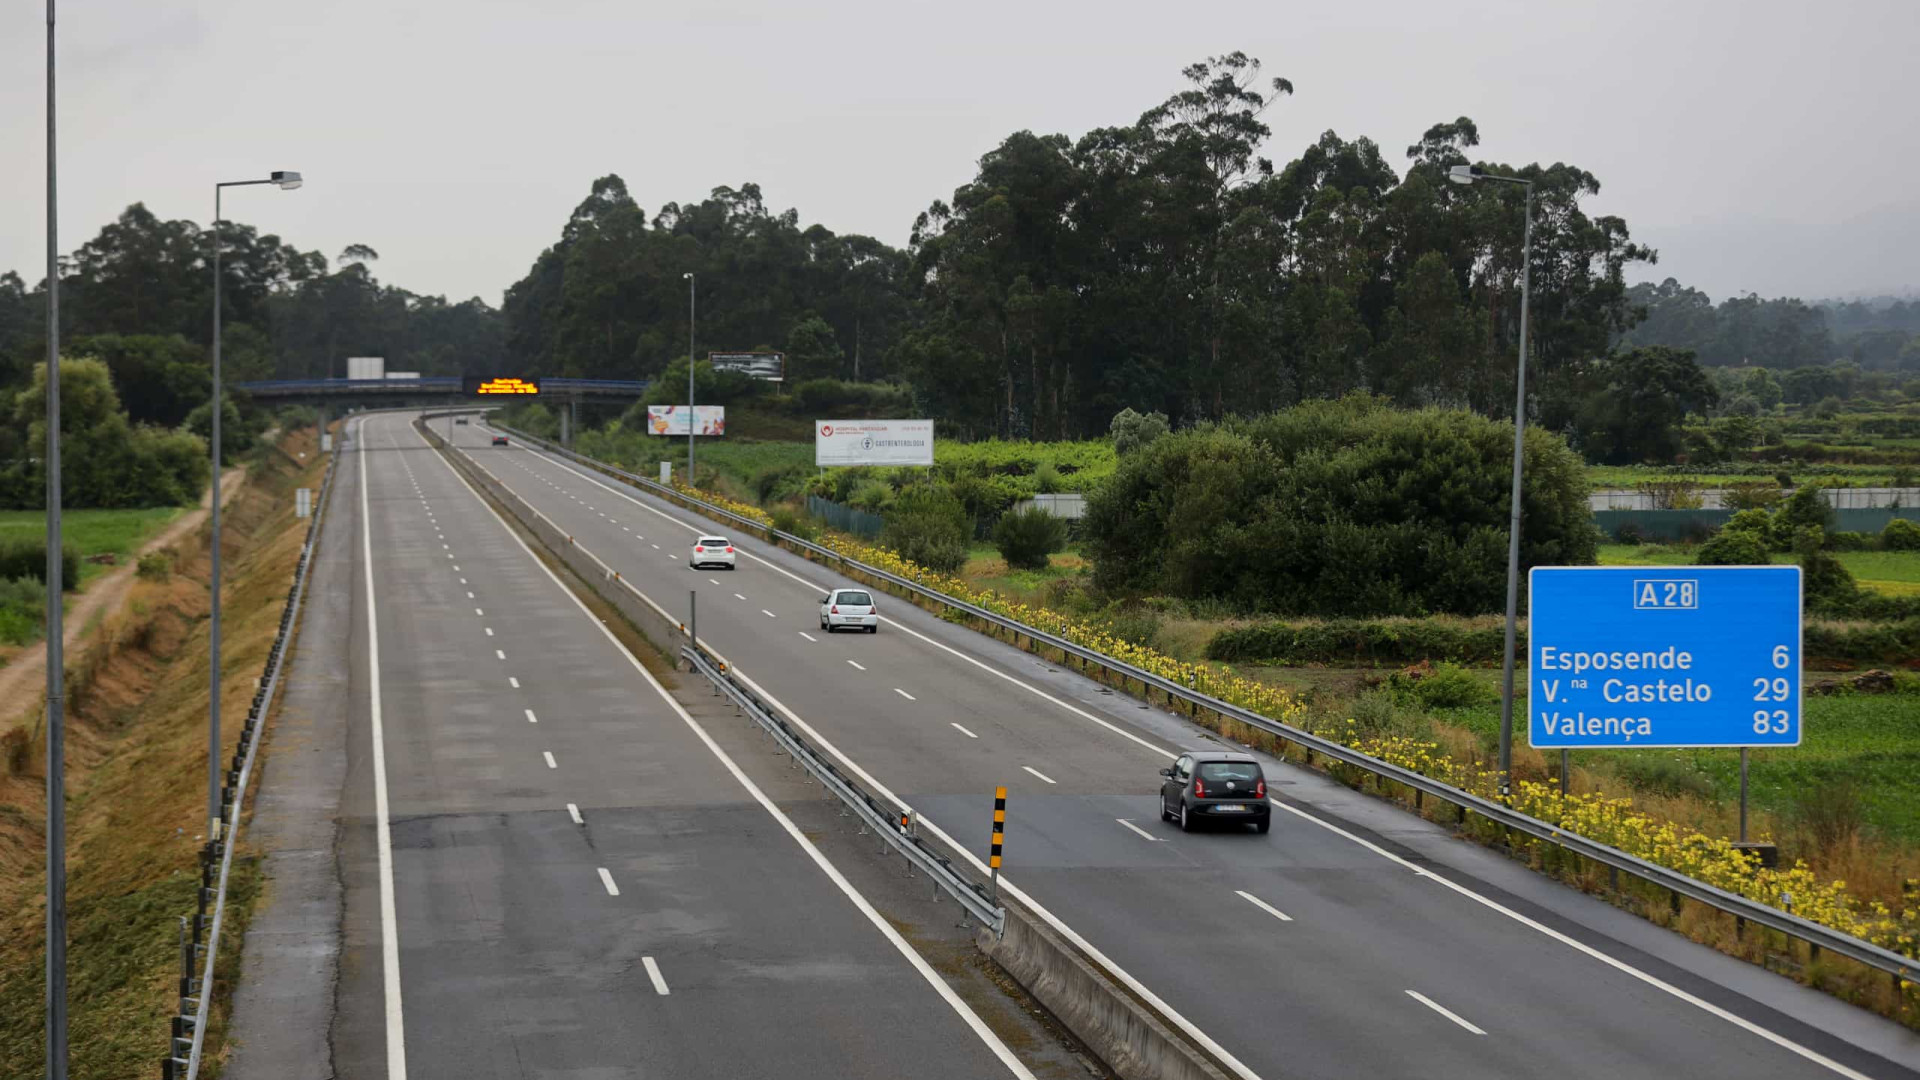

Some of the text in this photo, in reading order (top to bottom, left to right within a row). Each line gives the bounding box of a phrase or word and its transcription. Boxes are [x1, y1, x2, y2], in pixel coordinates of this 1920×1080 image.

[1542, 645, 1788, 673] Esposende 6
[1604, 679, 1710, 702] Castelo
[1754, 678, 1788, 701] 29
[1542, 710, 1788, 741] Valença 83
